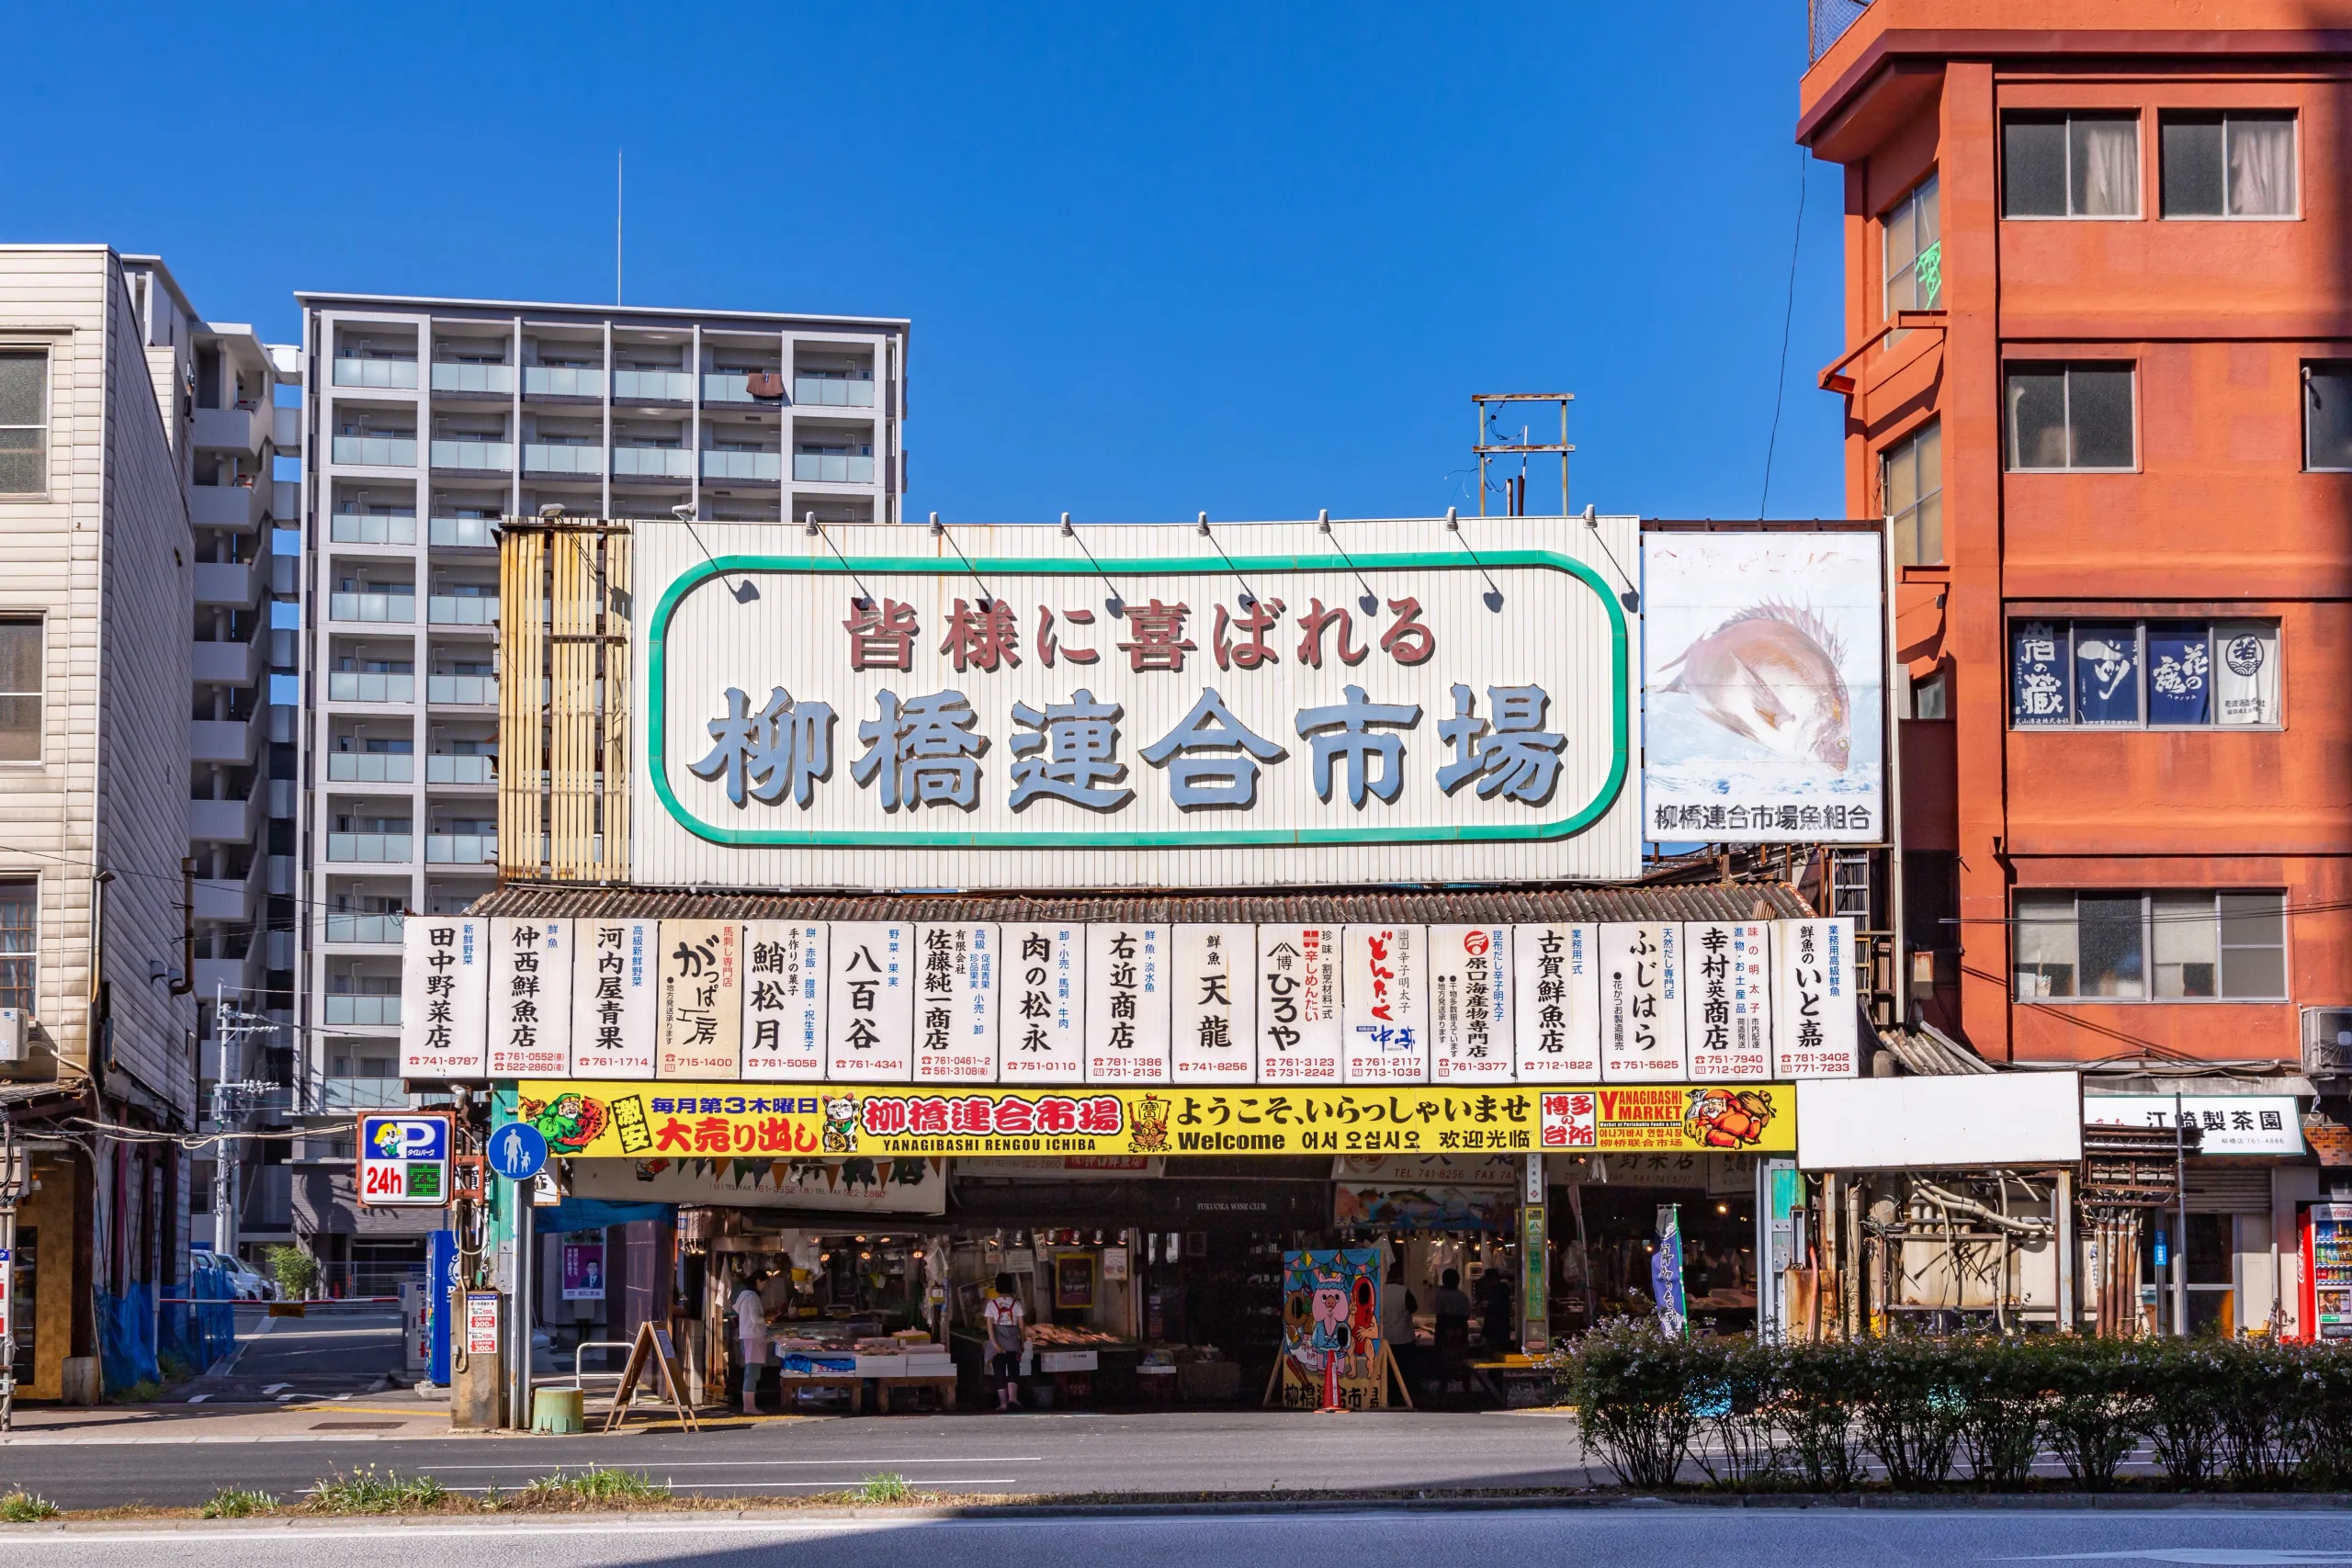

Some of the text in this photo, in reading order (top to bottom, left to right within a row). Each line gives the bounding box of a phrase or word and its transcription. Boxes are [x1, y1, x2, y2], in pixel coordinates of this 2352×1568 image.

[843, 596, 1435, 671] 皆様に喜ばれる
[688, 682, 1565, 809] 柳橋連合市場
[1655, 804, 1871, 830] 柳橋連合市場魚組合
[463, 924, 474, 964] 新鮮野菜
[548, 924, 559, 949] 鮮魚
[974, 929, 986, 950] 高級
[632, 925, 643, 987] 高級新鮮野菜
[722, 926, 733, 987] 馬刺し専門店
[787, 928, 799, 996] 手作りの菓子
[888, 929, 899, 987] 野菜・果実
[955, 929, 966, 975] 有限会社
[1572, 930, 1583, 975] 業務用一式
[1663, 928, 1674, 999] 天然だし専門店
[1828, 925, 1839, 997] 業務用高級鮮魚
[1368, 931, 1394, 1021] どんたく
[1493, 931, 1504, 1021] 昆布だし辛子明太子
[1747, 927, 1760, 1014] 味の明太子
[424, 927, 456, 1049] 田中野菜店
[510, 926, 541, 1047] 仲西鮮魚店
[595, 927, 625, 1049] 河内屋青果
[845, 944, 883, 1050] 八百谷
[922, 928, 954, 1050] 佐藤純一商店
[1019, 931, 1052, 1052] 肉の松永
[1108, 931, 1138, 1049] 右近商店
[1196, 934, 1232, 1048] 鮮魚 天龍
[1305, 951, 1318, 1021] 辛しめんたい
[1537, 930, 1566, 1054] 古賀鮮魚店
[1630, 931, 1657, 1051] ふじはら
[1701, 927, 1730, 1051] 幸村英商店
[1267, 974, 1301, 1051] ひろや
[1465, 957, 1489, 1058] 原口海産物専門店
[1751, 1018, 1759, 1049] 市内配達
[423, 1057, 479, 1066] 741-8787
[593, 1057, 648, 1066] 761-1714
[677, 1058, 732, 1067] 715-1400
[762, 1059, 817, 1067] 761-5058
[849, 1060, 903, 1068] 761-4341
[1021, 1062, 1076, 1070] 751-0110
[1106, 1058, 1162, 1066] 781-1386
[1107, 1068, 1162, 1077] 731-2136
[1192, 1063, 1248, 1071] 741-8256
[1279, 1058, 1334, 1066] 761-3123
[1279, 1068, 1334, 1077] 731-2242
[1365, 1068, 1421, 1077] 713-1038
[1452, 1062, 1507, 1071] 761-3377
[1537, 1061, 1593, 1070] 712-1822
[1623, 1061, 1679, 1069] 751-5625
[1707, 1055, 1763, 1064] 751-7940
[1708, 1066, 1763, 1074] 712-0270
[1794, 1054, 1849, 1062] 781-3402
[1794, 1064, 1849, 1072] 771-7233
[650, 1097, 818, 1115] 毎月第3木曜日
[864, 1097, 1121, 1134] 柳橋連合市場
[1177, 1094, 1532, 1125] ようこそ、いらっしゃいませ
[1544, 1095, 1593, 1116] 博多
[1599, 1090, 1682, 1120] YANAGIBASHI
[1619, 1106, 1682, 1120] MARKET
[615, 1096, 650, 1153] 激安
[655, 1117, 819, 1153] 大売り出し
[1439, 1129, 1532, 1149] 欢迎光临
[1544, 1125, 1594, 1145] 台所
[883, 1138, 1096, 1152] YANAGIBASHI RENGOU ICHIBA
[1178, 1132, 1285, 1150] Welcome
[1302, 1131, 1421, 1150] 어서 오십시오
[367, 1167, 401, 1193] 24h
[410, 1165, 441, 1197] 空
[1395, 1168, 1412, 1178] TEL
[1419, 1169, 1464, 1179] 741-8256
[1475, 1170, 1495, 1179] FAX
[753, 1186, 796, 1194] 61-0552
[1197, 1202, 1267, 1211] FUKUOKA WINE CLUB
